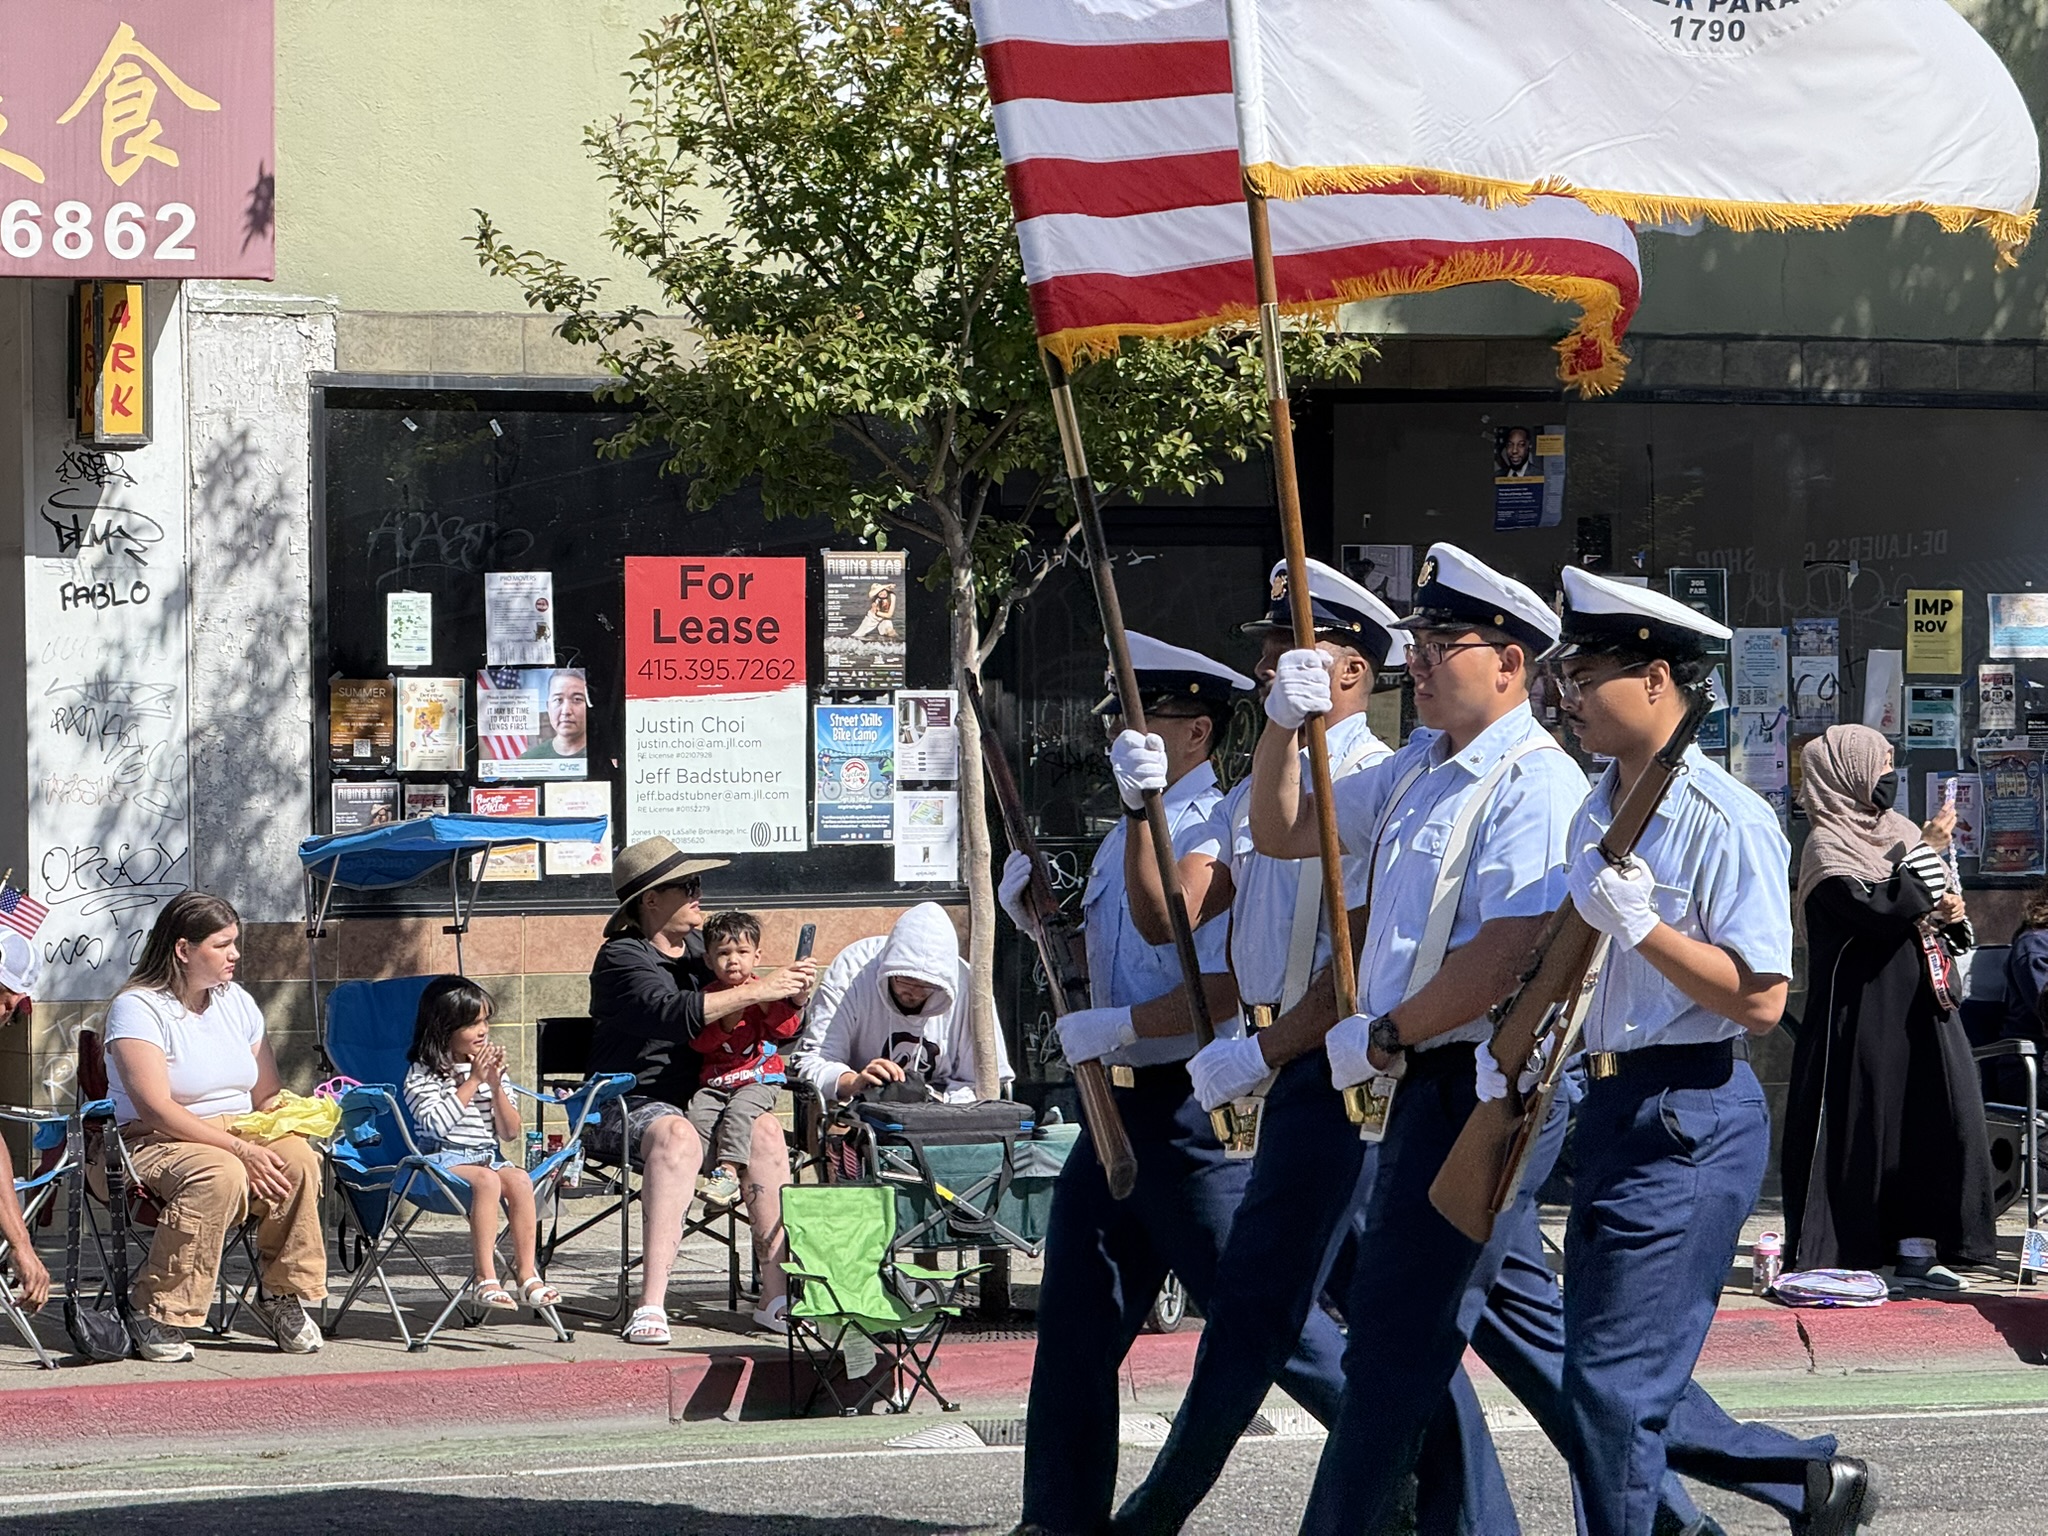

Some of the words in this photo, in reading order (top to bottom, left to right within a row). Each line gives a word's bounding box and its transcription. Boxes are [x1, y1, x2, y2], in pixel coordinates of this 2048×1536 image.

[1670, 15, 1746, 43] 1790
[0, 199, 197, 260] 6862
[108, 300, 136, 417] ARK
[827, 559, 868, 573] RISING
[870, 559, 902, 573] SEAS
[680, 564, 754, 600] For
[1914, 598, 1953, 616] IMP
[653, 608, 780, 645] Lease
[1914, 620, 1948, 633] ROV
[637, 658, 796, 680] 415.395.7262
[338, 687, 387, 697] SUMMER
[487, 707, 493, 715] IT
[493, 707, 505, 715] MAY
[507, 707, 514, 715] BE
[516, 707, 530, 715] TIME
[490, 715, 498, 723] TO
[499, 715, 510, 723] PUT
[511, 715, 527, 723] YOUR
[635, 716, 694, 734] Justin
[701, 716, 745, 733] Choi
[829, 712, 859, 727] Street
[860, 712, 883, 727] Skills
[488, 723, 508, 731] LUNGS
[832, 727, 851, 742] Bike
[852, 728, 878, 743] Camp
[637, 738, 762, 751] justin.choi@am.jll.com
[635, 767, 671, 785] Jeff
[676, 767, 782, 784] Badstubner
[337, 788, 368, 798] RISING
[635, 790, 790, 803] jeff.badstubner@am.jll.com
[631, 828, 651, 837] Jones
[653, 828, 671, 837] Lang
[772, 826, 802, 843] JLL
[707, 1076, 723, 1088] GO
